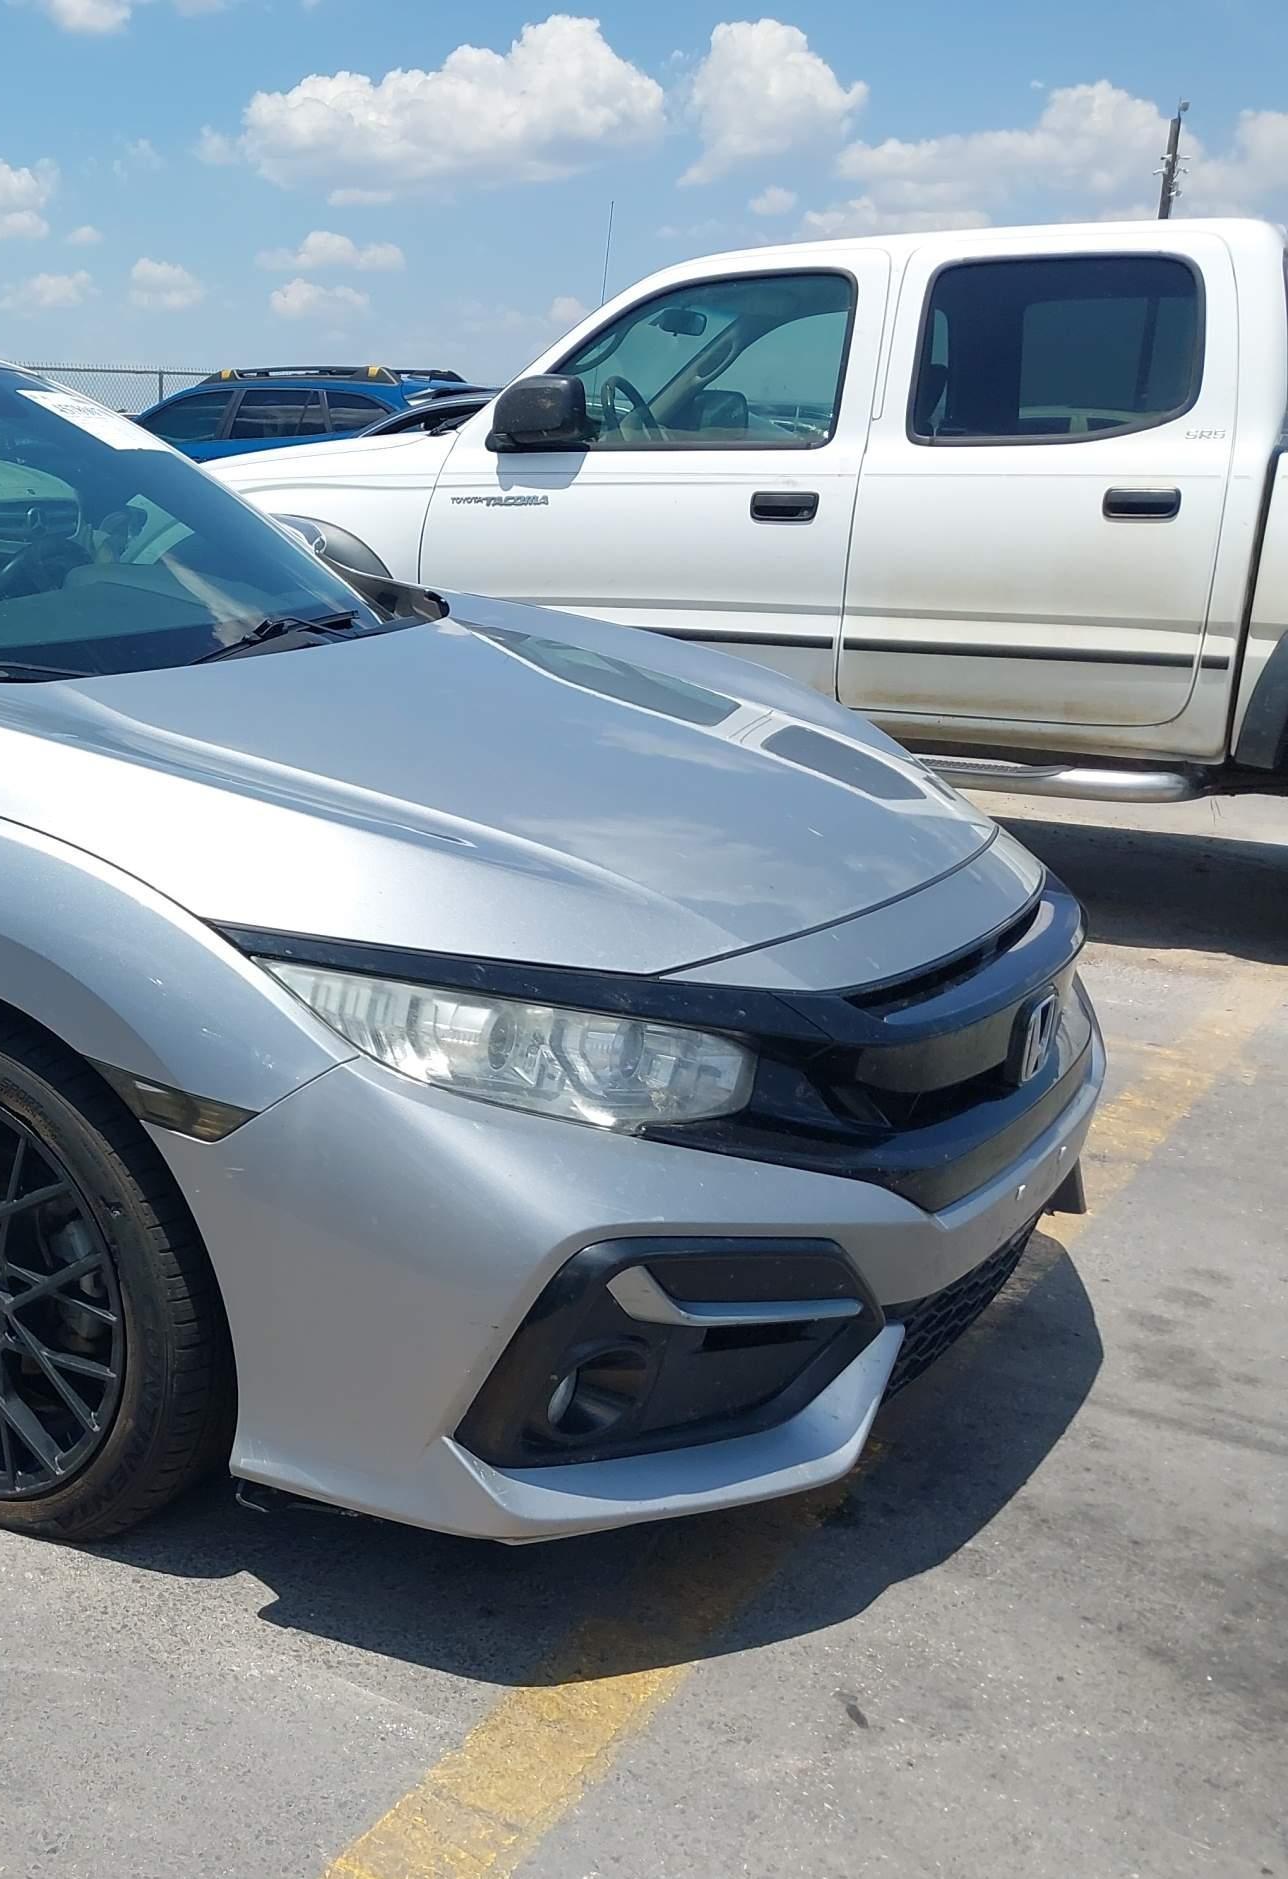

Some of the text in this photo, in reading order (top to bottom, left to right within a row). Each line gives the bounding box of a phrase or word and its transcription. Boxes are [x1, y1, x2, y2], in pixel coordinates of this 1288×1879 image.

[1185, 429, 1226, 440] SR5
[450, 495, 549, 507] TOYOTA TACOMA
